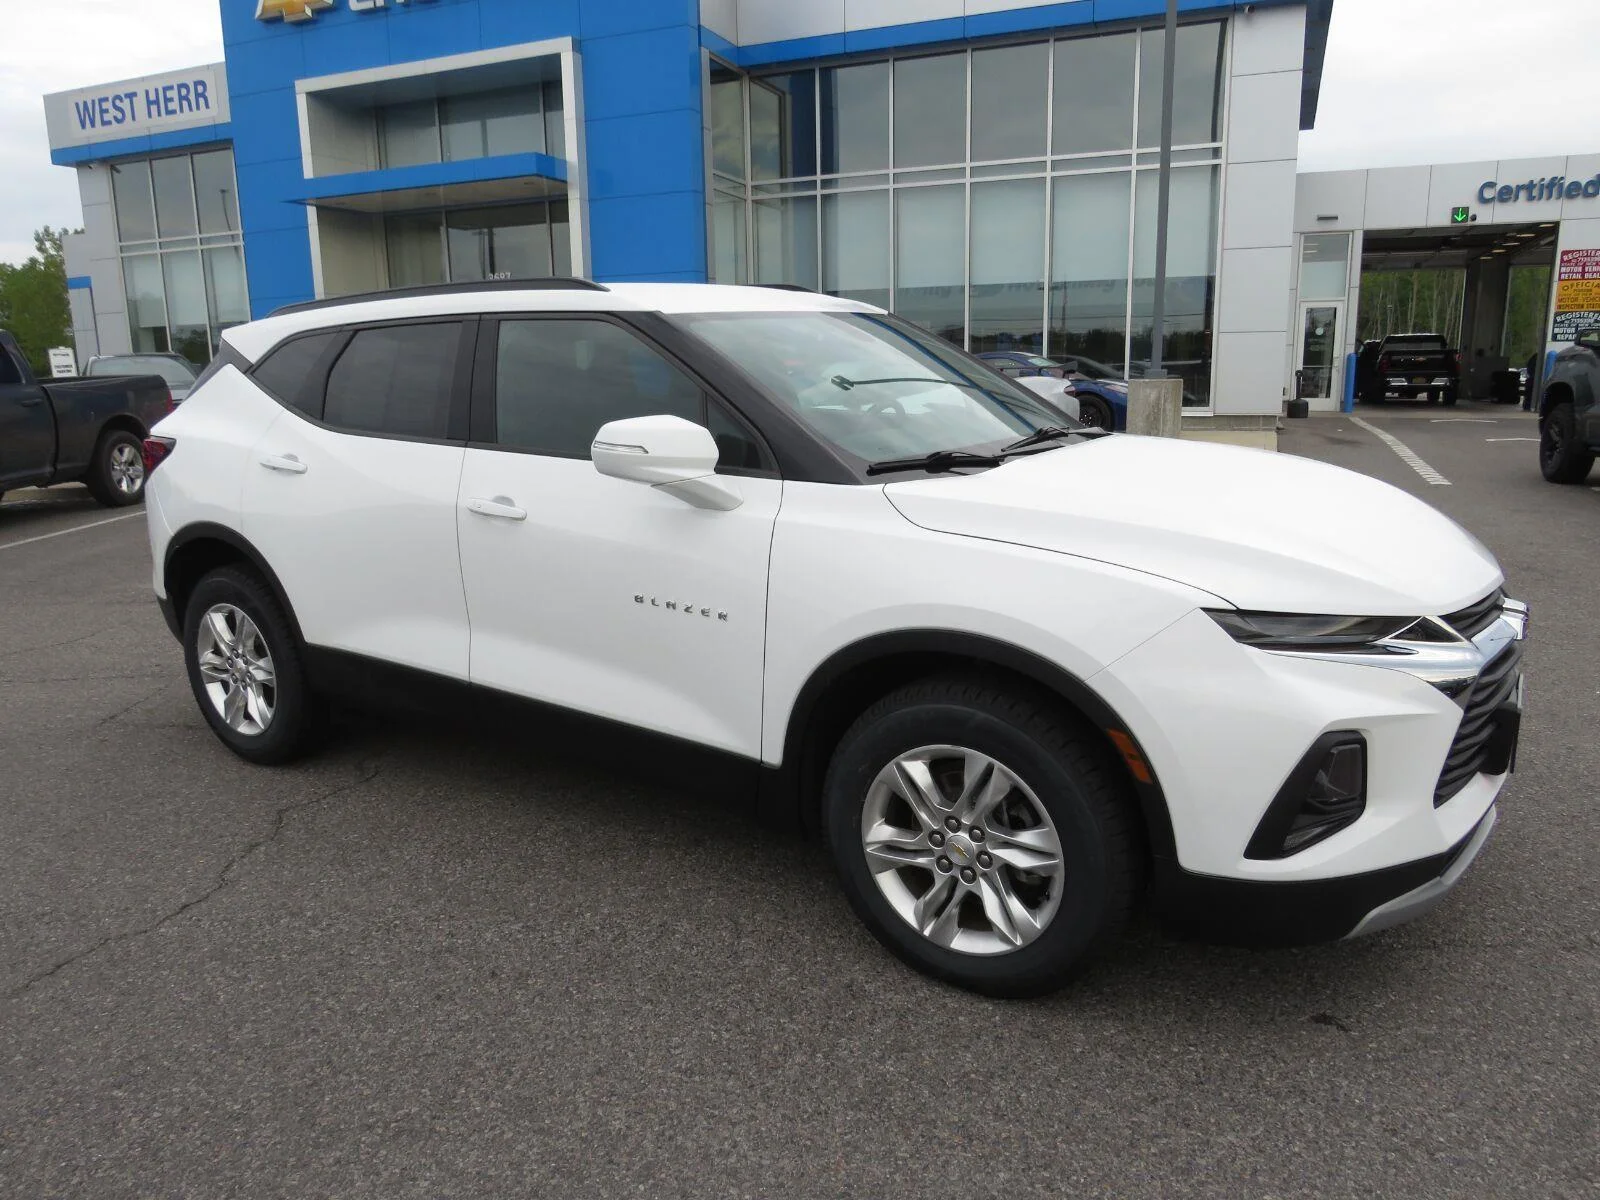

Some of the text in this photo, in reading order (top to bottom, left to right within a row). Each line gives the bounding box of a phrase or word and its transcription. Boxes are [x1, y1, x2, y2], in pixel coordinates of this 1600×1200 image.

[74, 79, 211, 130] WEST HERR
[1478, 173, 1600, 205] Certified
[633, 593, 729, 622] BLAZER
